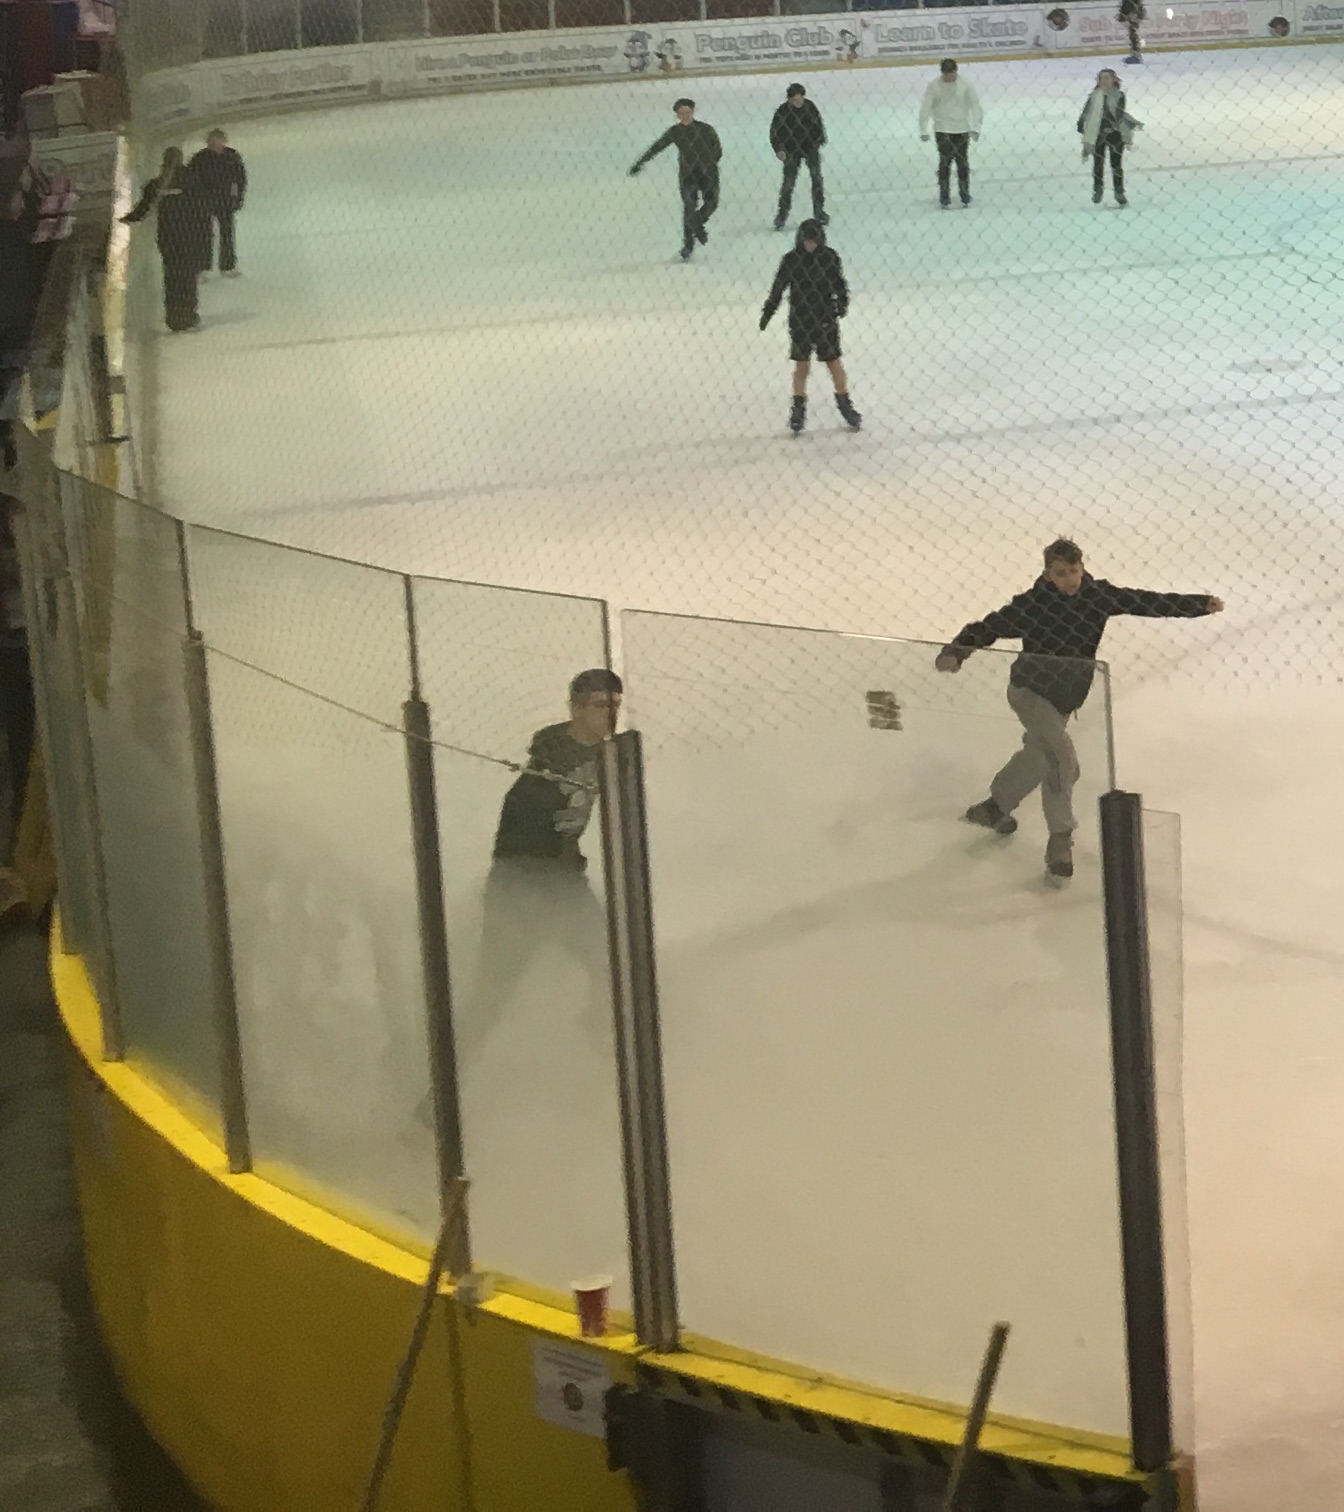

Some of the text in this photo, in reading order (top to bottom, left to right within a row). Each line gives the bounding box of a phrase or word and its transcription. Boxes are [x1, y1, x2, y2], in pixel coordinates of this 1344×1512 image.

[694, 25, 835, 55] Penguin Club
[874, 17, 1029, 43] Learn to Skate
